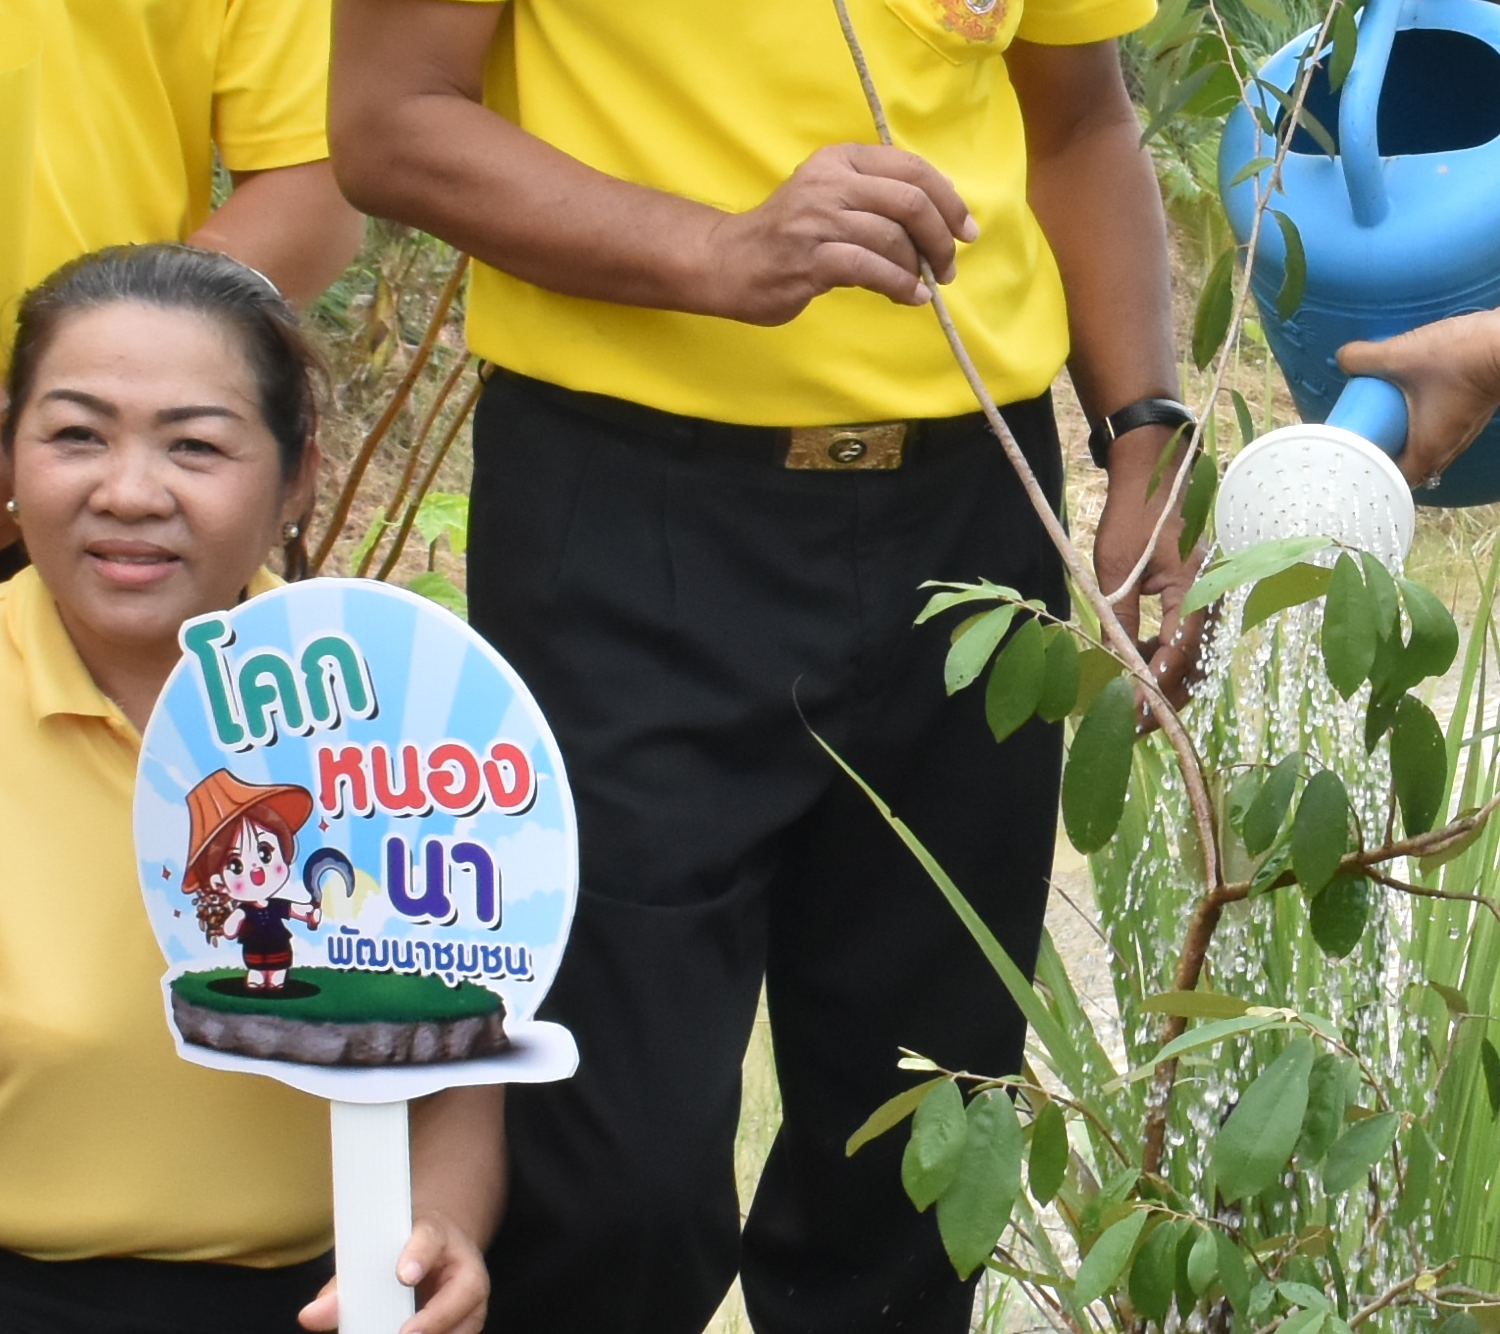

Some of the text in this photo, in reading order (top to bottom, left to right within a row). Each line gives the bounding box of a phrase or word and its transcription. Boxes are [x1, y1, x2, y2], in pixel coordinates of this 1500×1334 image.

[184, 619, 368, 746] โคก
[319, 743, 530, 812] หนอง
[386, 836, 495, 924] นา
[327, 925, 529, 984] พัฒนาชุมชน
